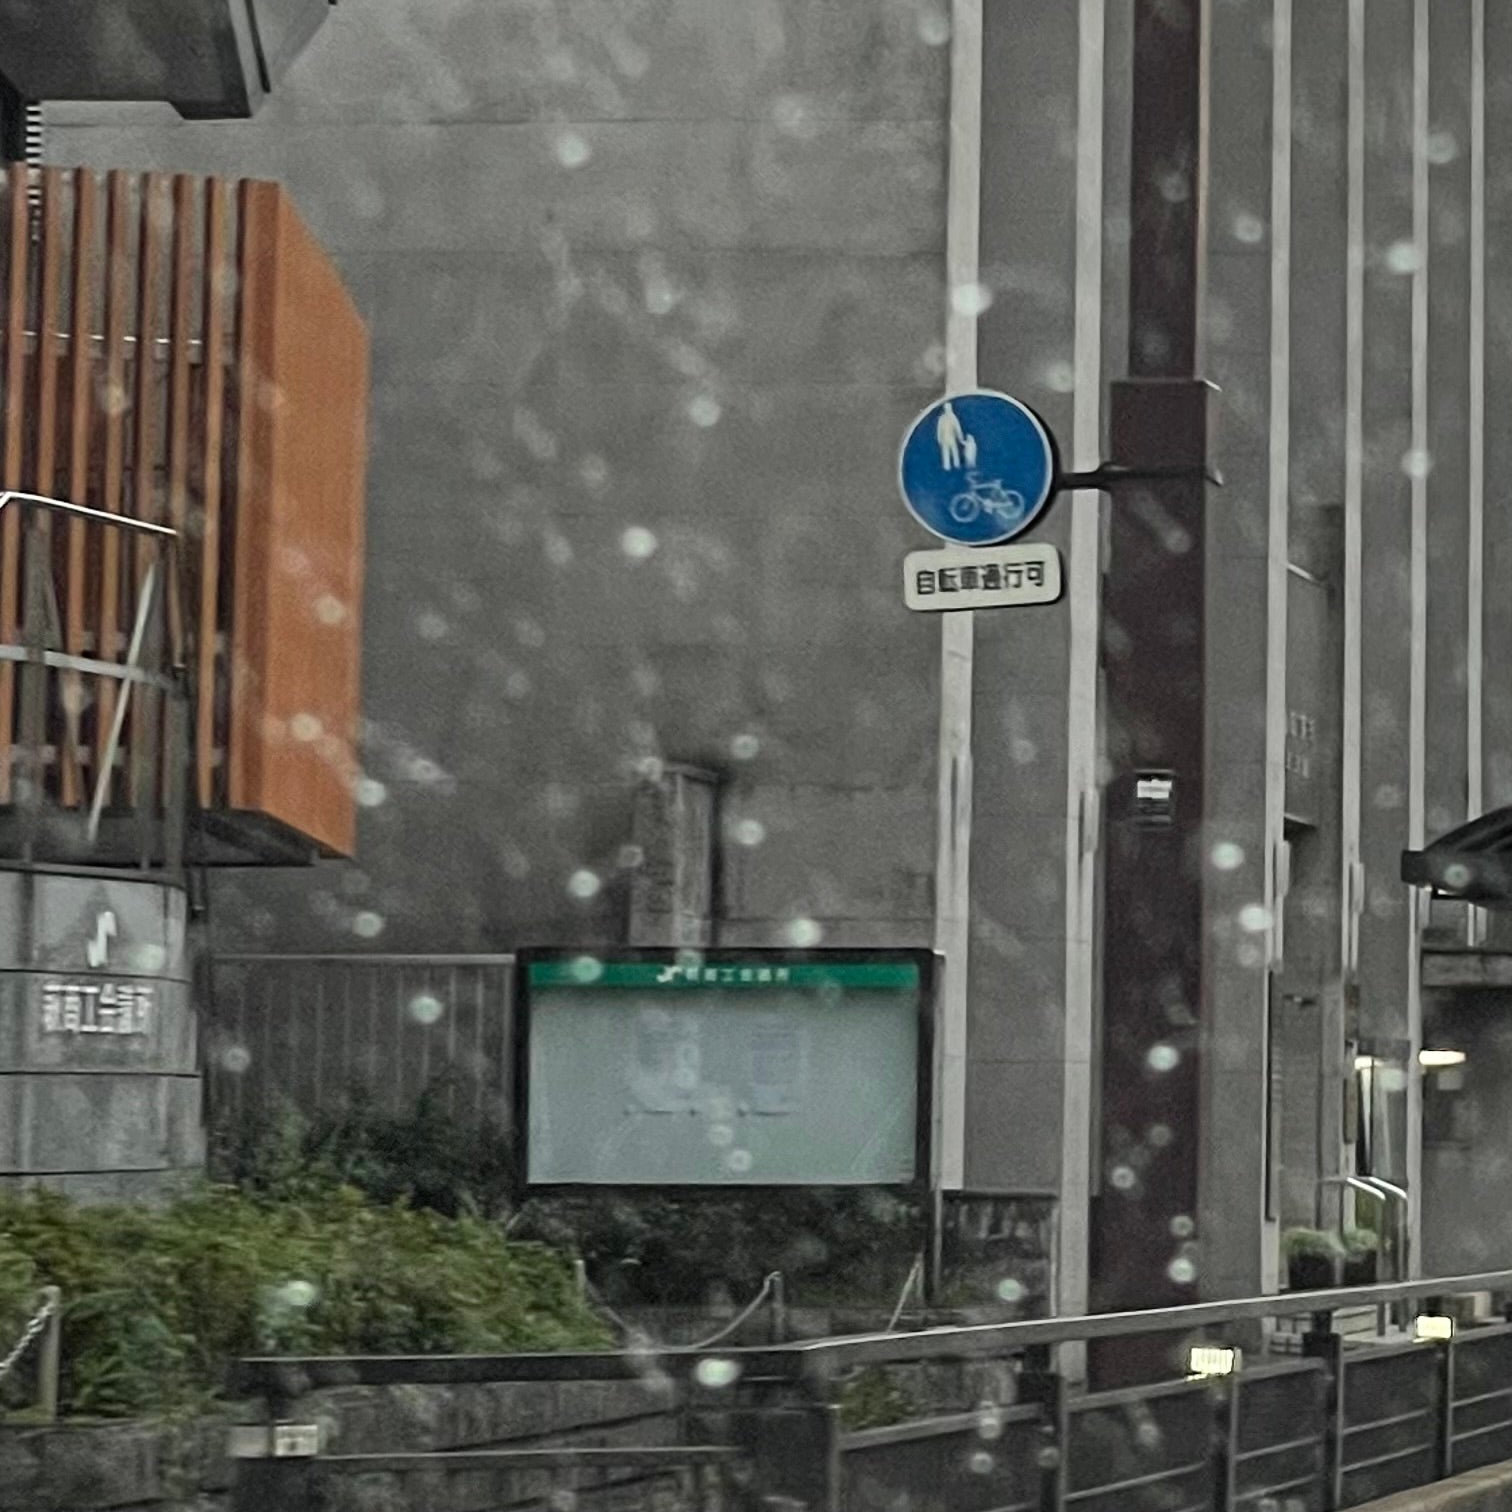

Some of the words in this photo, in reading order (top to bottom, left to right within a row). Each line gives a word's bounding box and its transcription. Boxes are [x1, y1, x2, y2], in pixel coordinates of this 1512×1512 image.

[917, 561, 1044, 595] 自転車通行可
